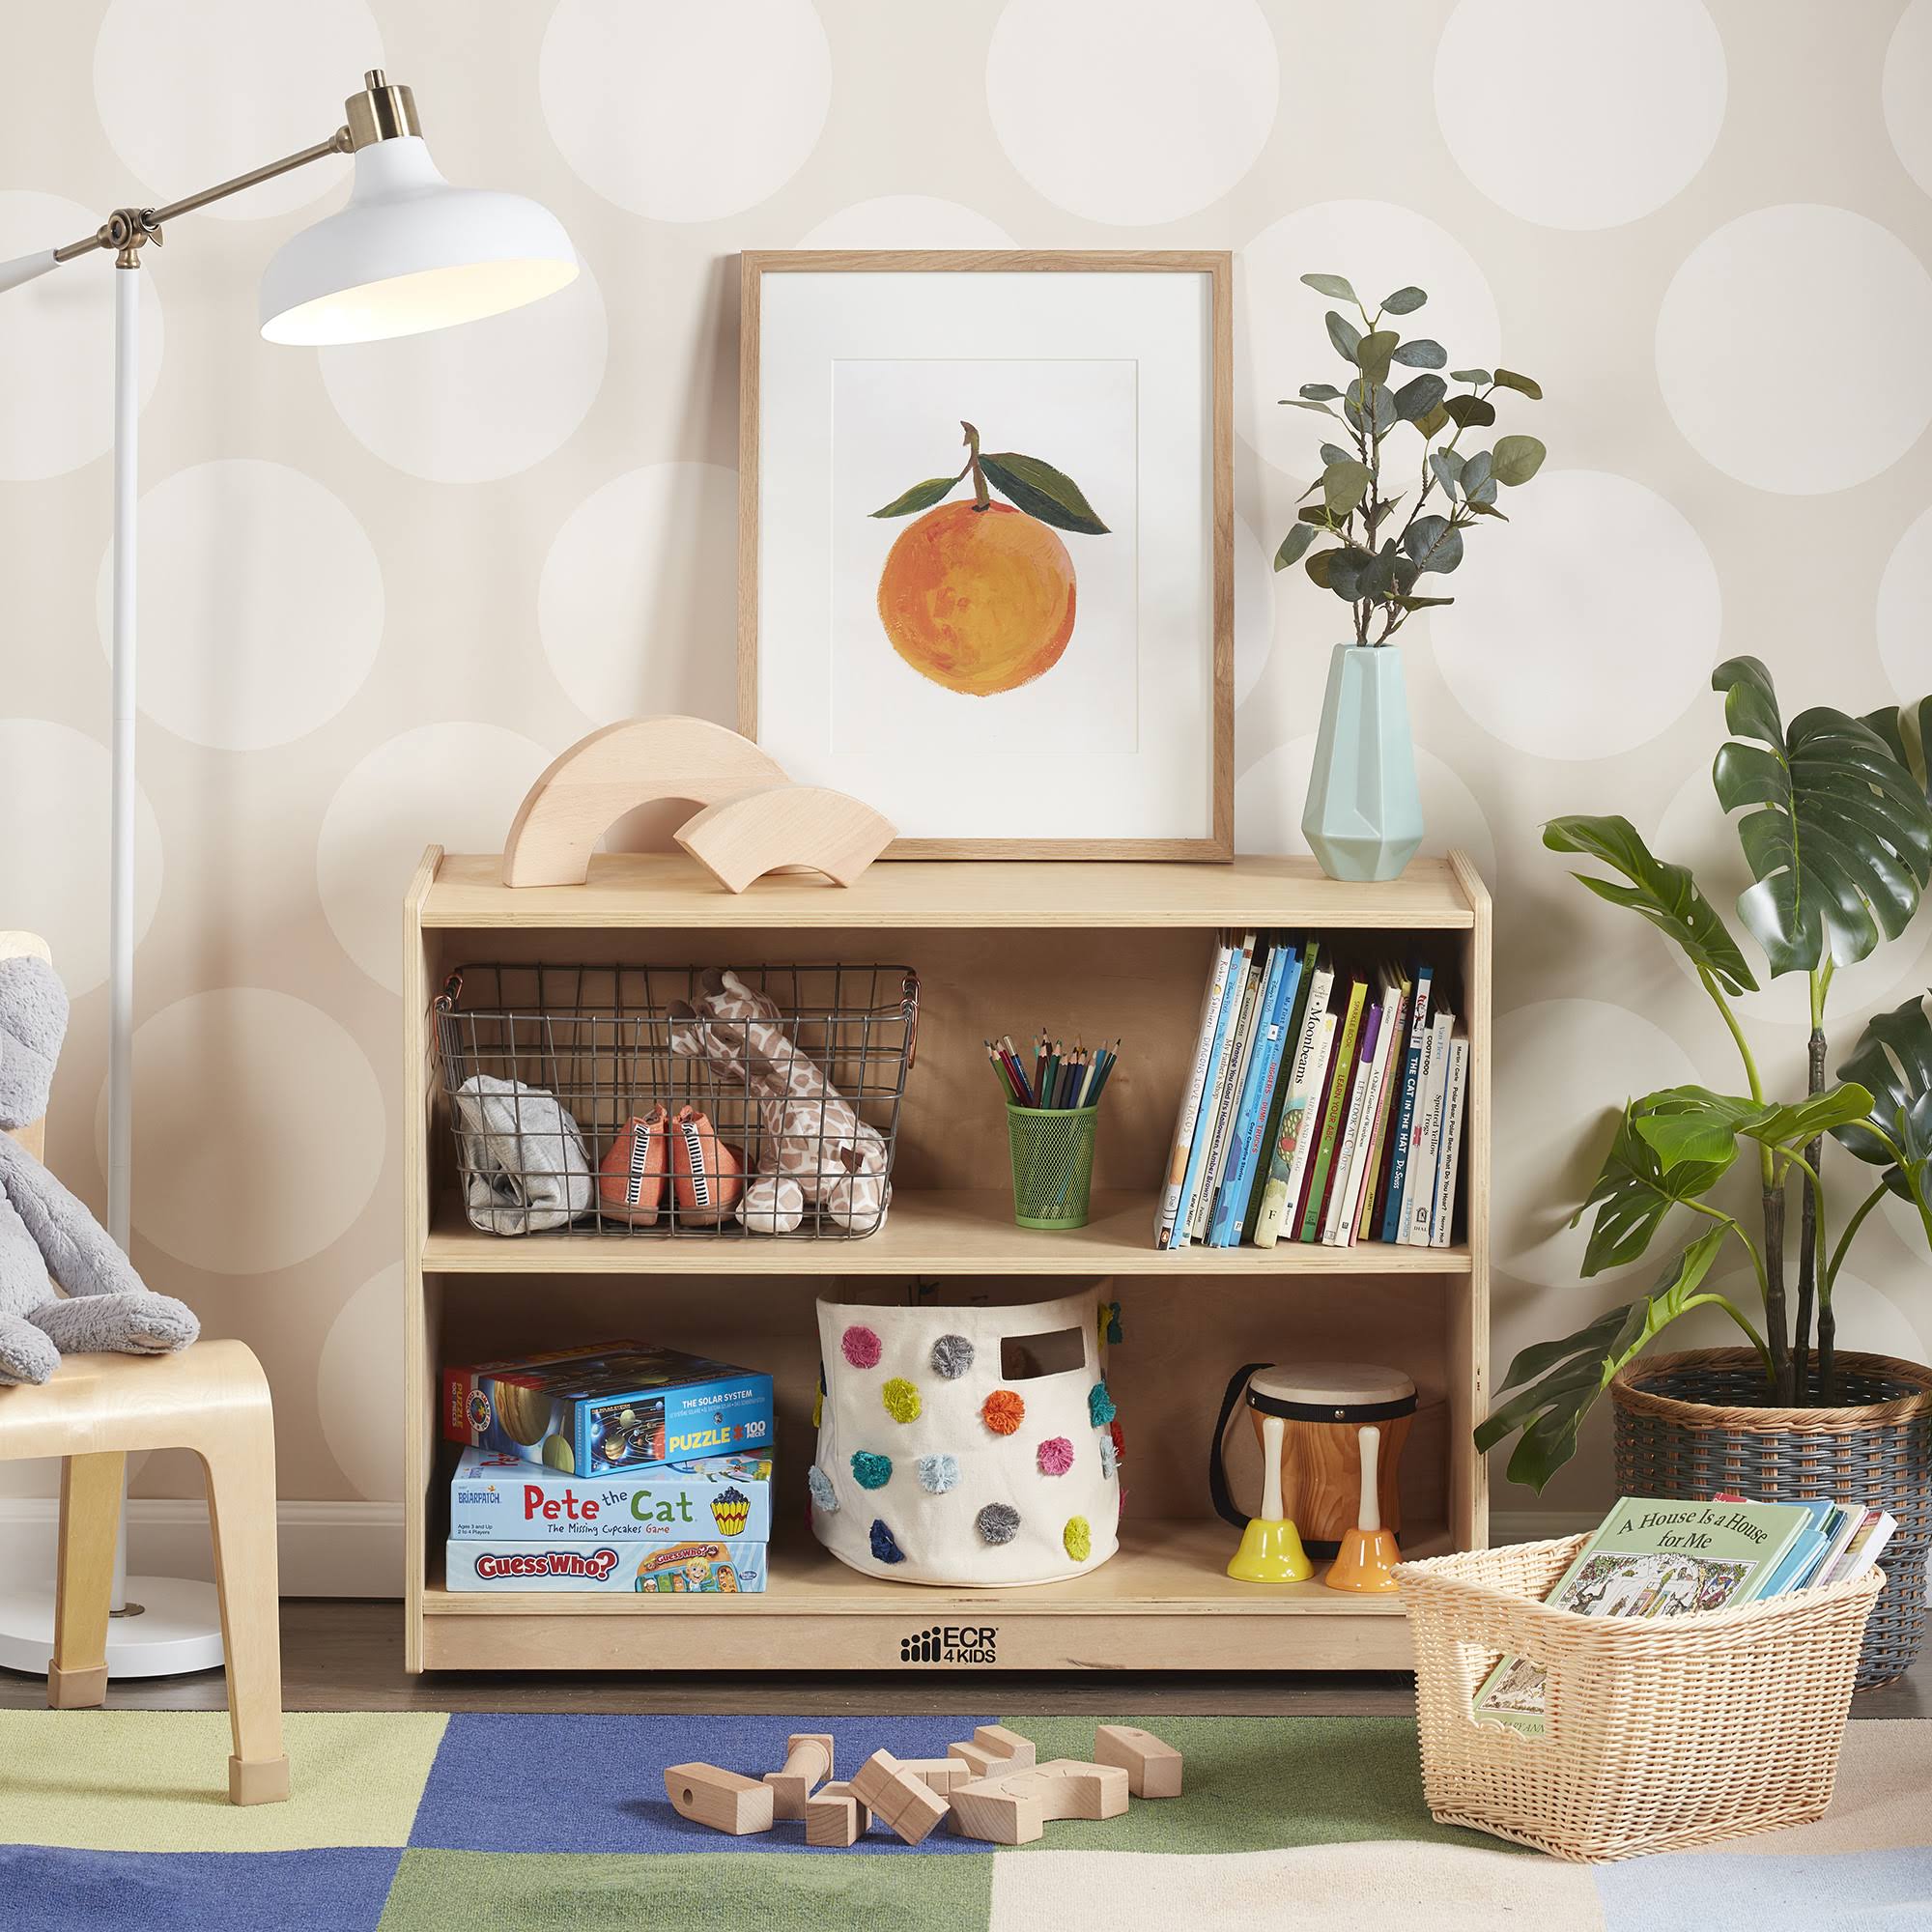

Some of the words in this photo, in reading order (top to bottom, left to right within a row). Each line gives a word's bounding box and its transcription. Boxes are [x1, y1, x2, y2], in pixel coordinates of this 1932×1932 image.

[1217, 960, 1228, 983] Rubin
[1207, 997, 1220, 1029] Salmieri
[1284, 996, 1292, 1008] My
[1224, 1038, 1233, 1052] My
[1295, 1007, 1322, 1086] Moonbeams
[1346, 1029, 1354, 1049] BOOK
[1197, 1037, 1211, 1075] DRAGONS
[1231, 1041, 1243, 1068] Orange
[1424, 1036, 1433, 1076] COOTY-DOO
[1218, 1052, 1230, 1080] Father's
[1409, 1057, 1419, 1075] THE
[1192, 1078, 1202, 1100] LOVE
[1265, 1062, 1277, 1095] DIGGERS
[1334, 1074, 1345, 1099] LEARN
[1406, 1078, 1416, 1097] CAT
[1213, 1081, 1223, 1100] Shop
[1225, 1082, 1234, 1100] Glad
[1330, 1100, 1339, 1121] YOUR
[1351, 1102, 1361, 1124] LOOK
[1406, 1100, 1412, 1110] IN
[1432, 1094, 1442, 1127] Spotted
[1184, 1103, 1197, 1134] TACOS
[1424, 1114, 1433, 1136] Frogs
[1212, 1111, 1228, 1151] Halloween,
[1253, 1124, 1264, 1153] TRUCKS
[1326, 1125, 1335, 1142] ABC
[1349, 1126, 1355, 1138] AT
[1399, 1133, 1408, 1153] HAT
[1208, 1151, 1218, 1176] Amber
[1341, 1139, 1353, 1172] Colors
[1238, 1161, 1247, 1181] Stories
[1394, 1171, 1404, 1190] Seuss
[1445, 1171, 1451, 1179] Do
[1202, 1176, 1213, 1203] Brown?
[682, 1400, 697, 1408] THE
[697, 1395, 723, 1406] SOLAR
[724, 1389, 752, 1401] SYSTEM
[745, 1420, 765, 1434] 100
[669, 1427, 730, 1453] PUZZLE
[524, 1485, 599, 1520] Pete
[602, 1491, 628, 1507] the
[630, 1490, 694, 1522] Cat
[547, 1524, 564, 1533] The
[568, 1522, 598, 1536] Missing
[603, 1523, 641, 1536] Cupcakes
[645, 1523, 670, 1534] Game
[1617, 1519, 1634, 1536] A
[1638, 1512, 1696, 1529] House
[1697, 1509, 1713, 1525] Is
[1714, 1515, 1725, 1526] a
[1724, 1513, 1768, 1544] House
[1656, 1530, 1683, 1547] for
[1681, 1532, 1713, 1549] Me
[476, 1553, 548, 1579] Guess
[546, 1548, 618, 1581] Who?
[656, 1552, 682, 1564] Guess
[680, 1544, 709, 1559] Who?
[944, 1627, 996, 1648] ECR
[944, 1650, 954, 1662] 4
[957, 1650, 996, 1662] KIDS
